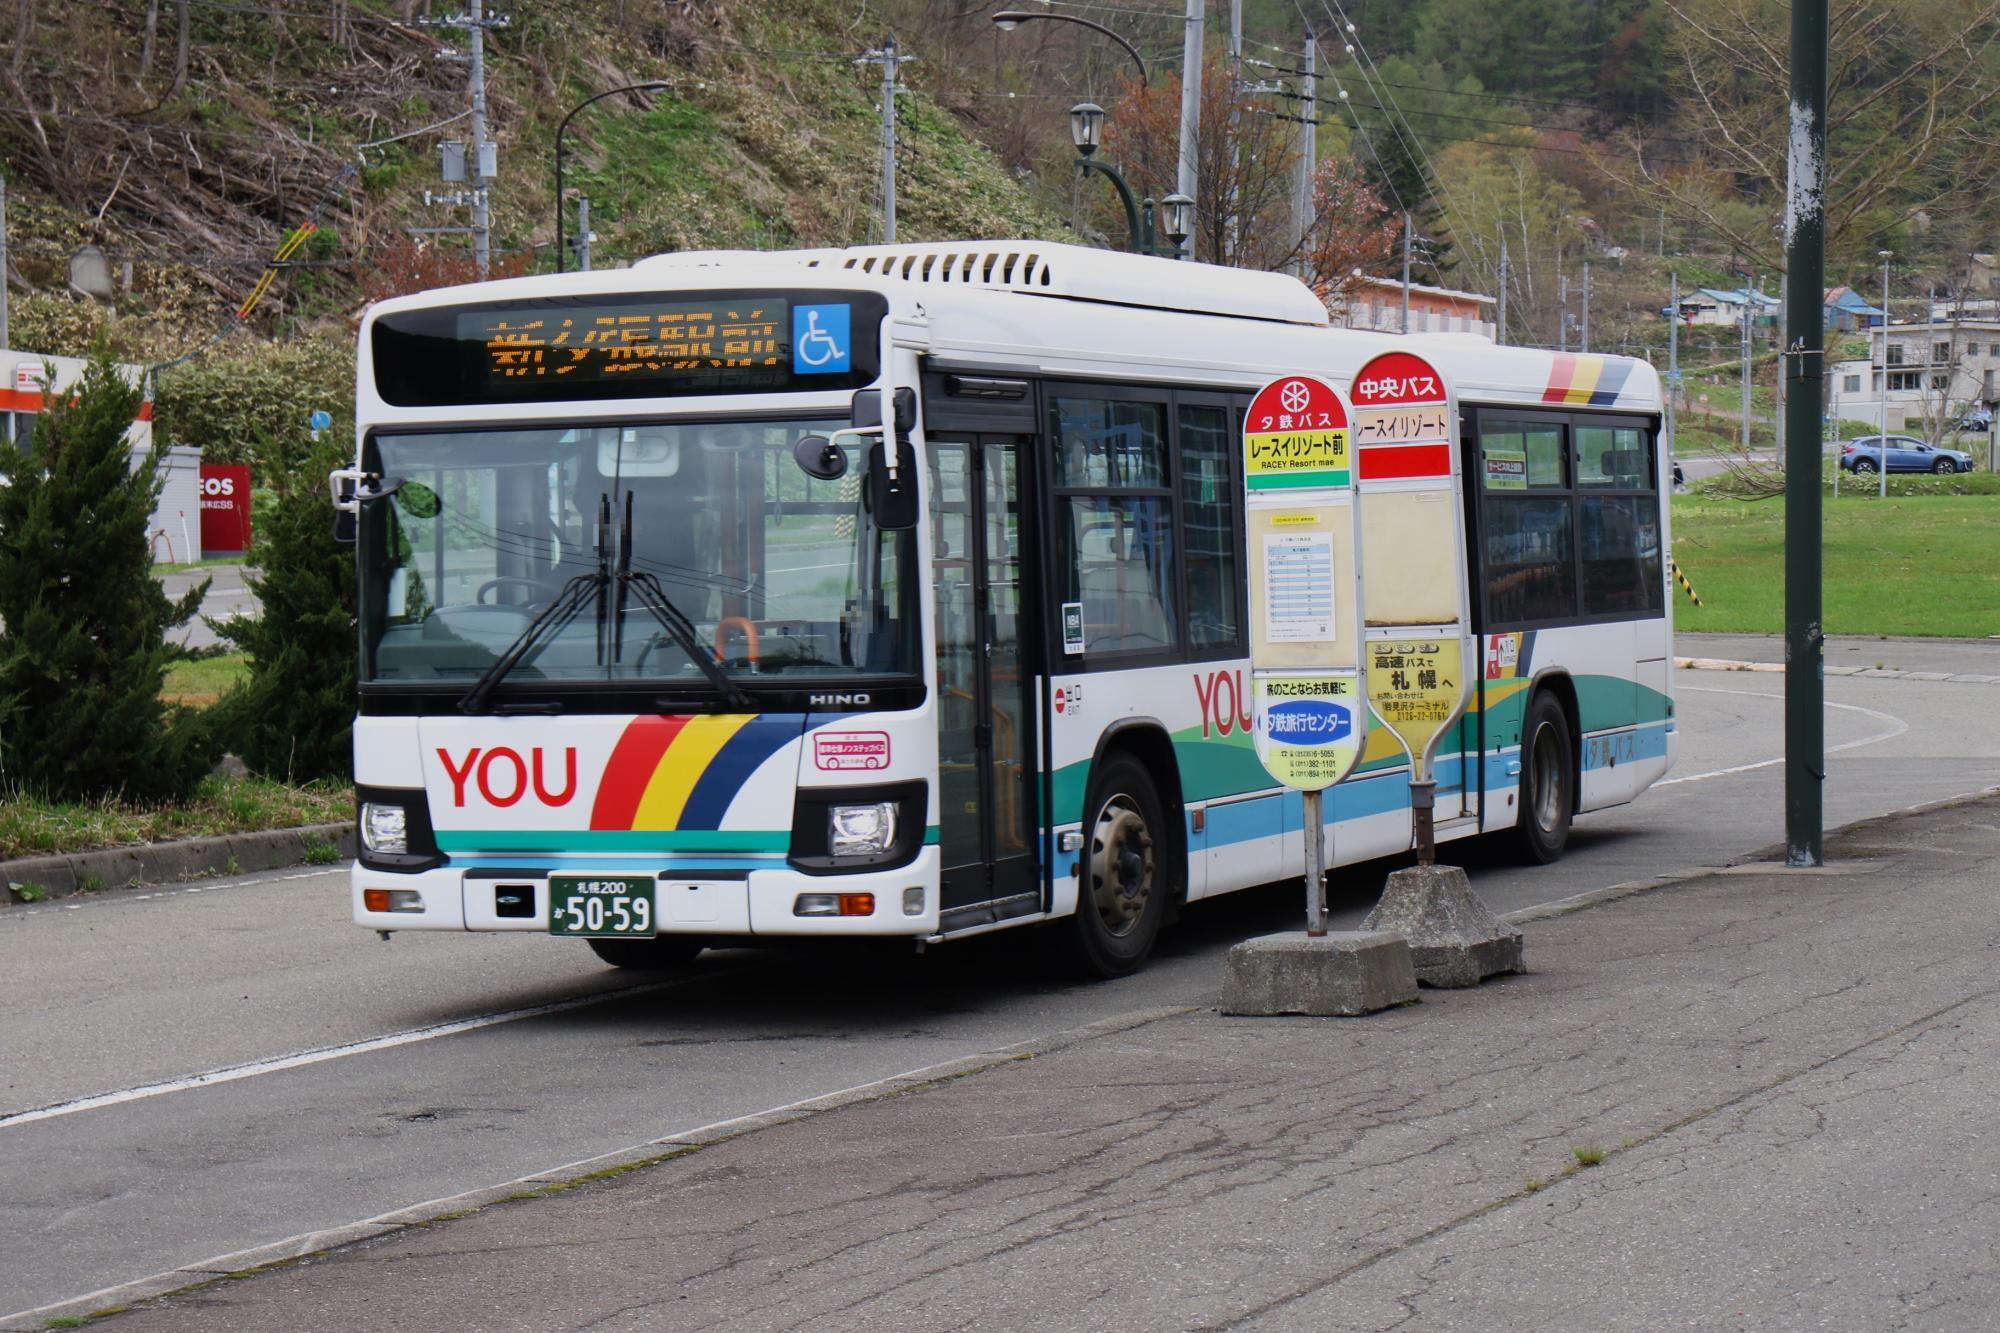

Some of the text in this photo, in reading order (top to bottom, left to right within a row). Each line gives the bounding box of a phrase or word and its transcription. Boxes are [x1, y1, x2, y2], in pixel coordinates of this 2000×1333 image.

[1360, 376, 1437, 399] 中央バス
[1261, 413, 1331, 429] 夕鉄バス
[1252, 434, 1343, 458] レースイリゾート前
[1261, 461, 1287, 469] RACEY
[1290, 459, 1316, 468] Resort
[1375, 656, 1434, 669] 高速バスで
[810, 694, 871, 705] HINO
[436, 747, 577, 807] YOU
[567, 896, 650, 931] 50-59
